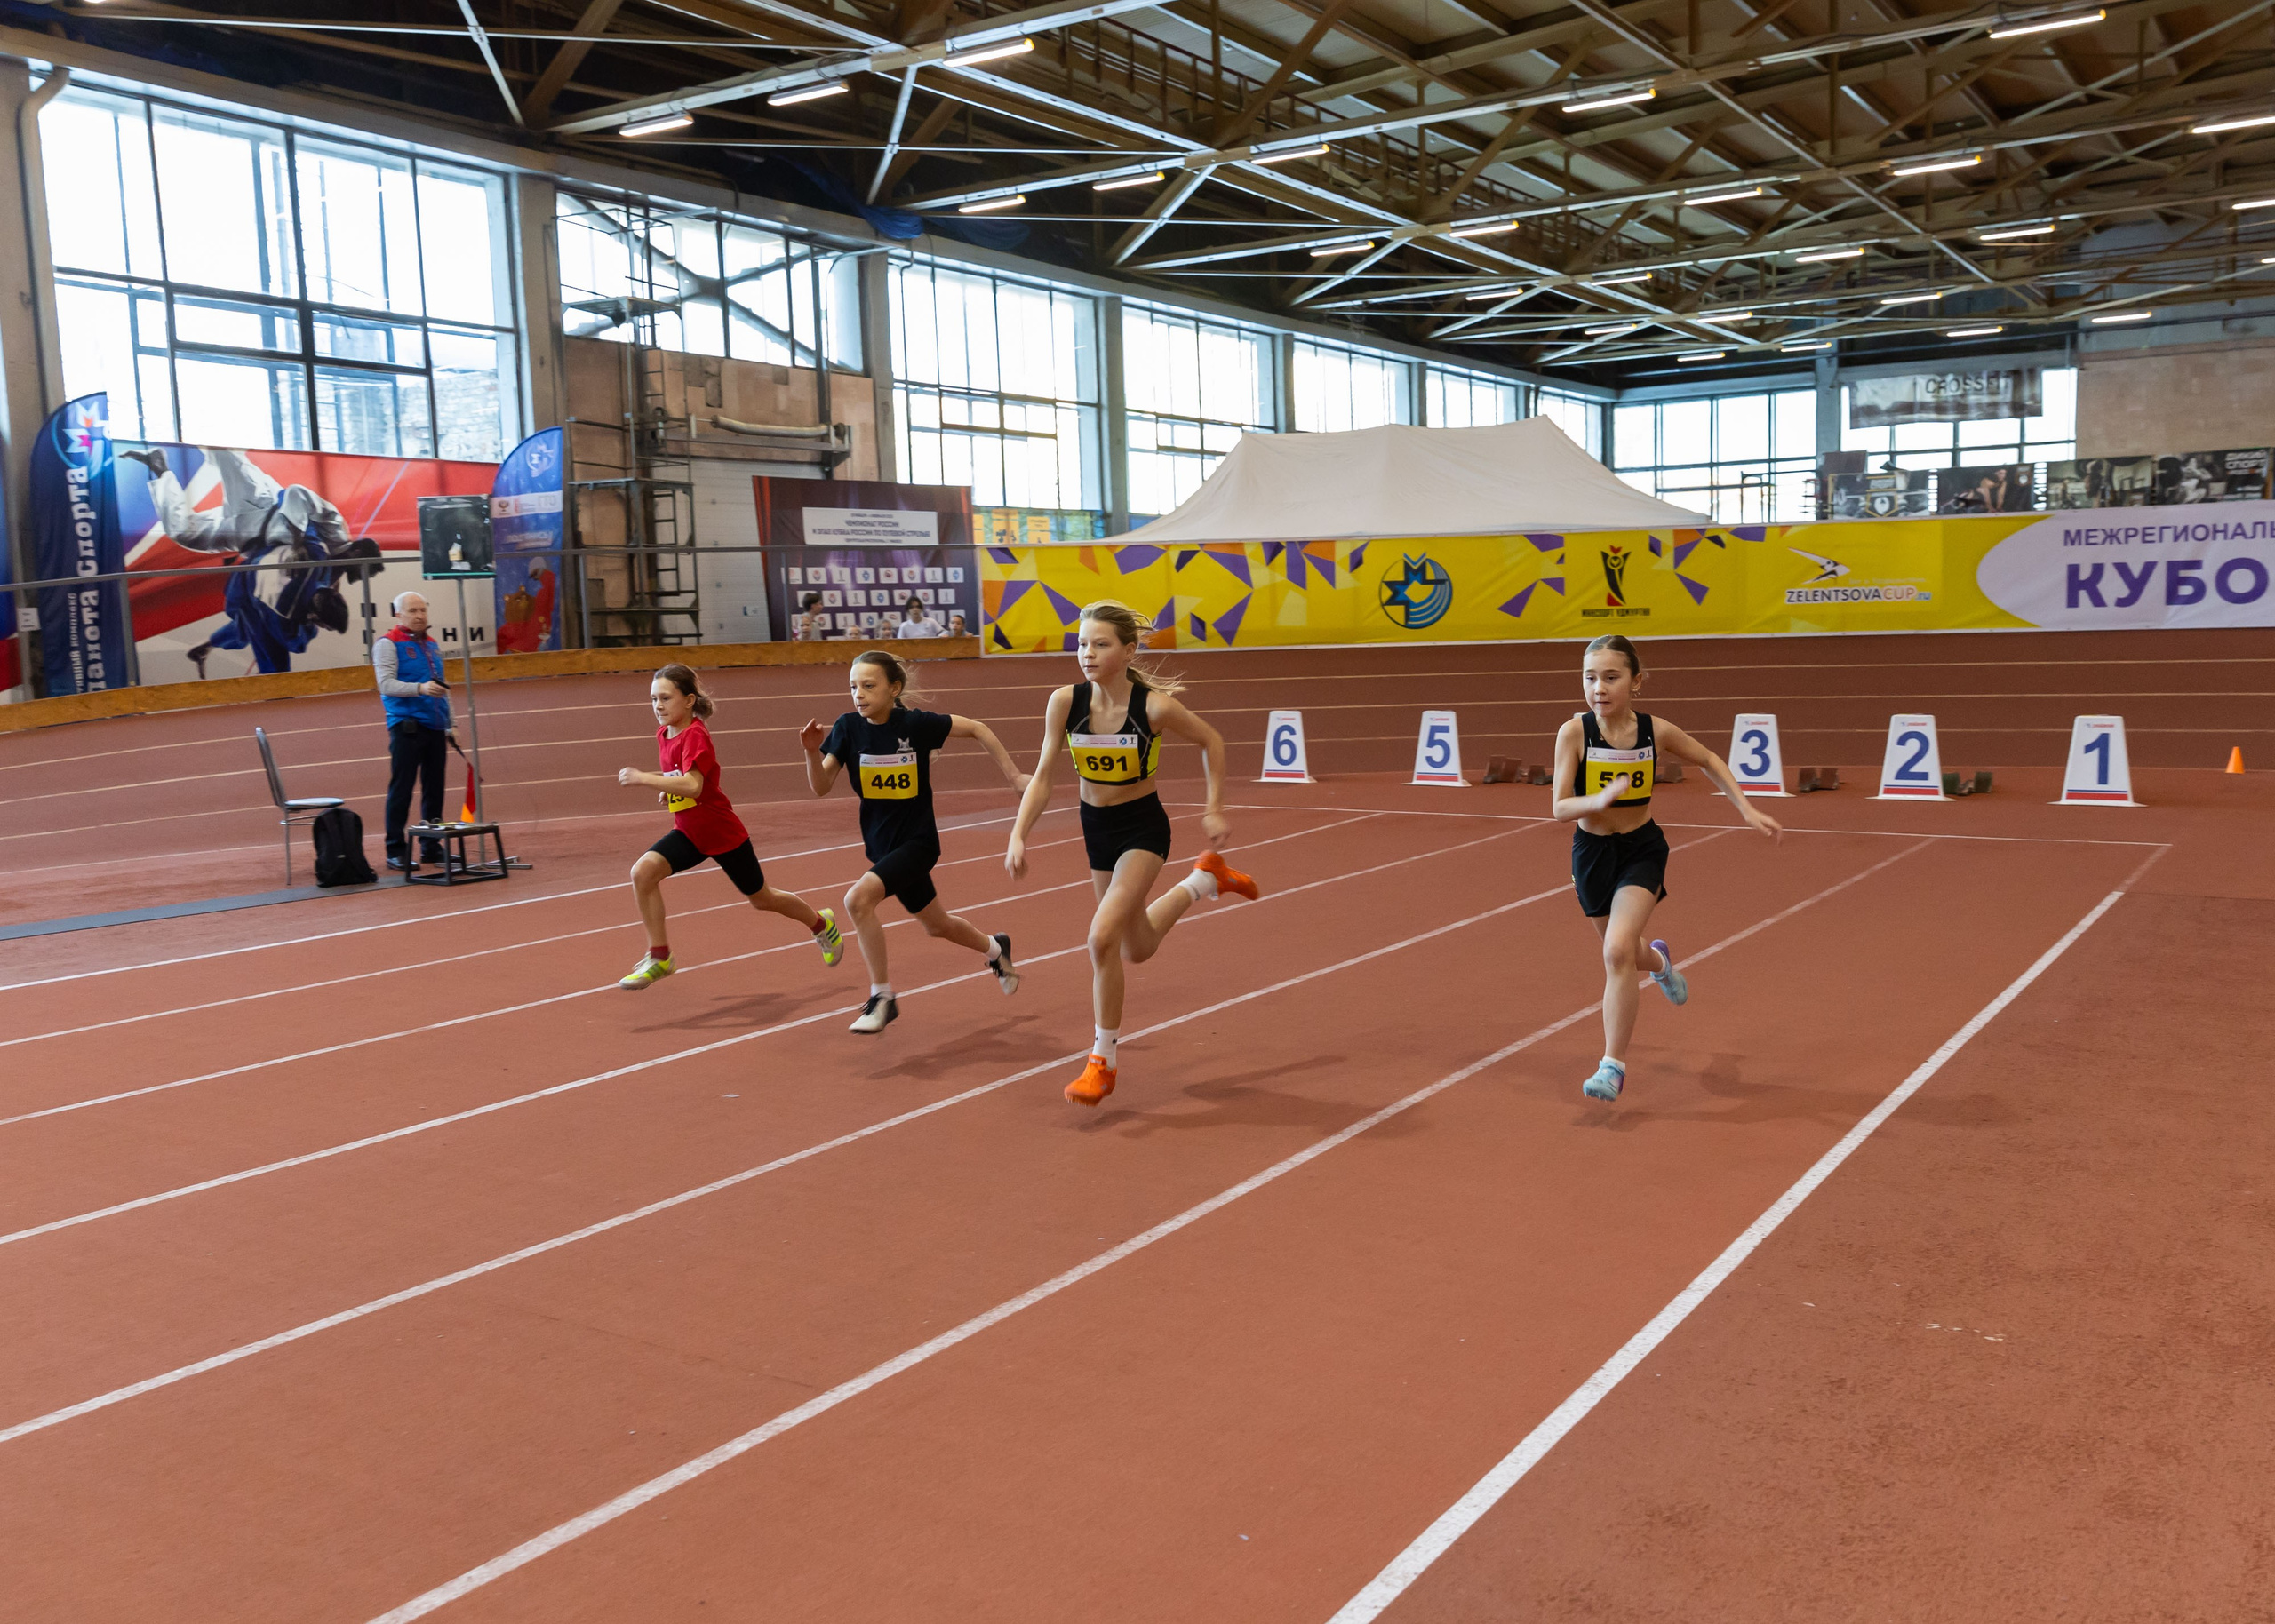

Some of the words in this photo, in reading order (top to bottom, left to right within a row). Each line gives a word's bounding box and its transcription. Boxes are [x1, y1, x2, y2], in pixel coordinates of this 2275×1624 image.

[2065, 557, 2270, 609] КУБО
[1086, 755, 1127, 772] 691
[1273, 725, 1297, 766] 6
[1425, 725, 1450, 768] 5
[1739, 729, 1770, 777] 3
[1895, 730, 1929, 781] 2
[2084, 733, 2110, 785] 1
[871, 773, 911, 790] 448
